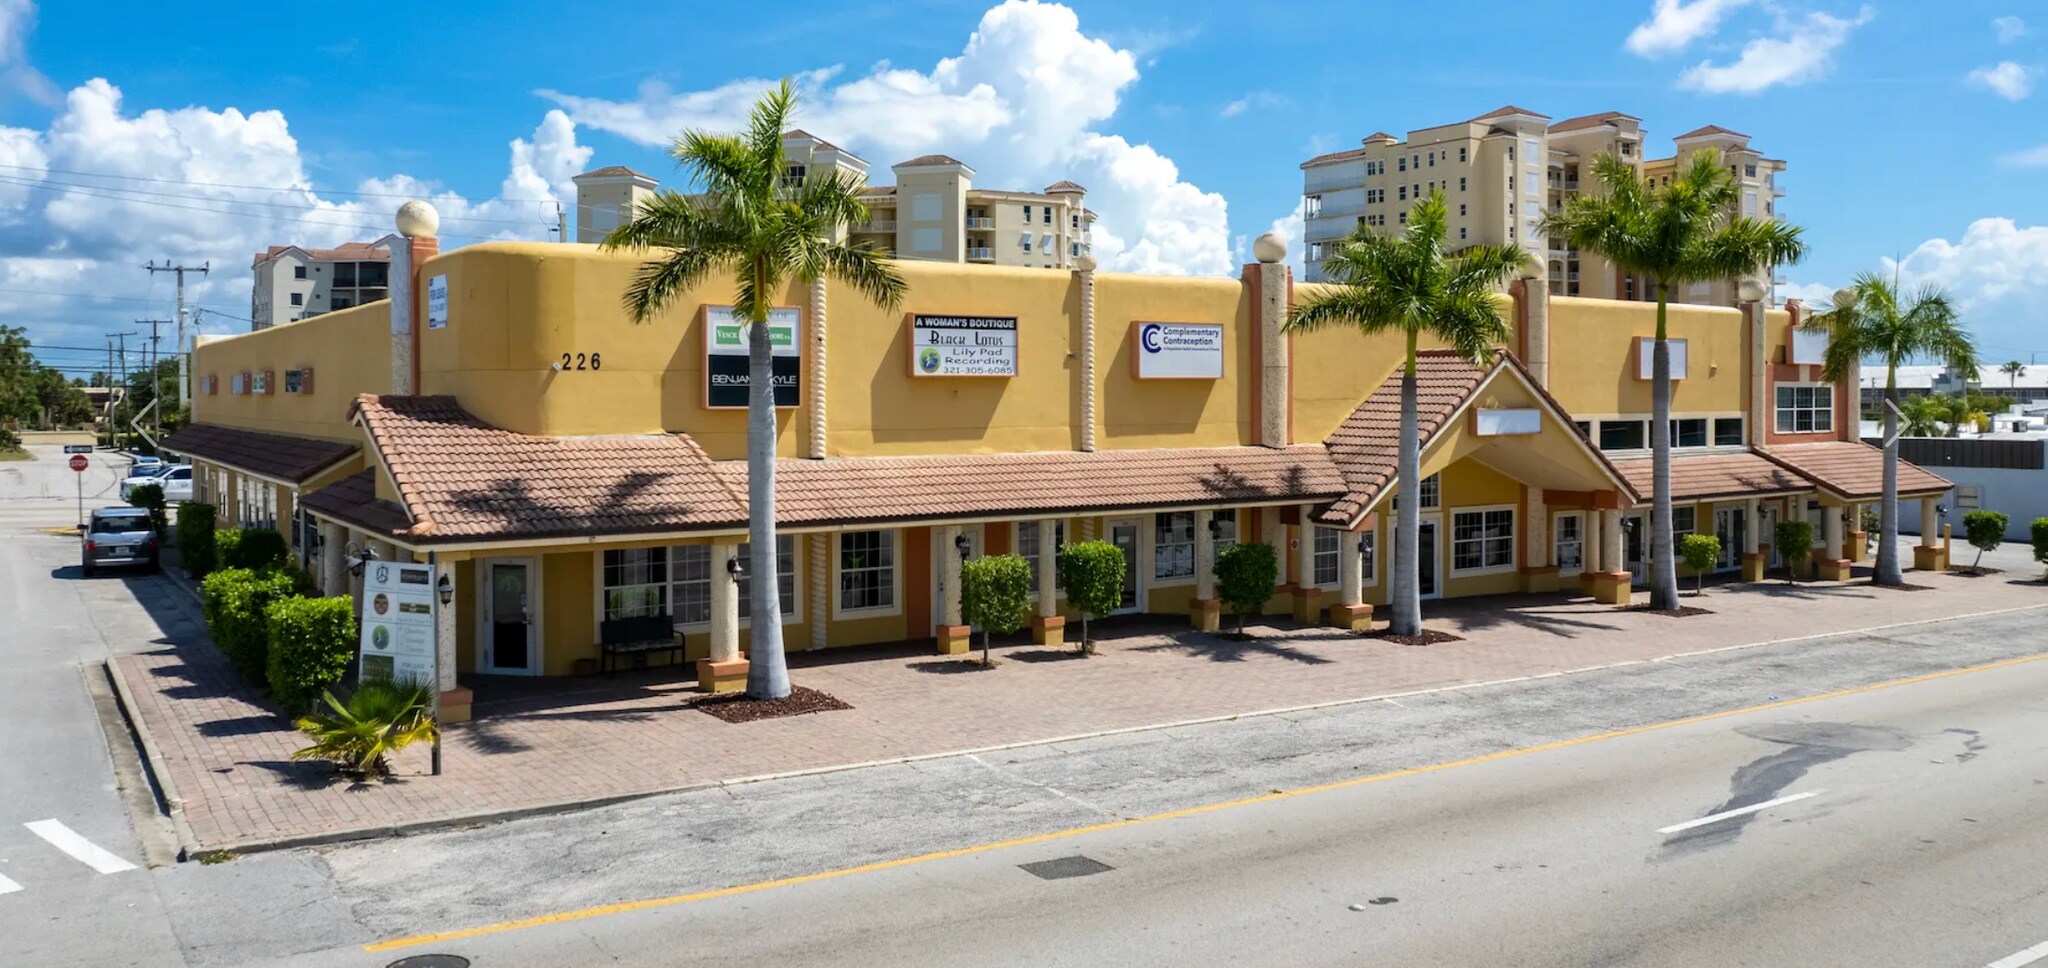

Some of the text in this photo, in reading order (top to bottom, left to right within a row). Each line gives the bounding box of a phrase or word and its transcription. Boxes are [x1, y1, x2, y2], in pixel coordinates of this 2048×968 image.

[916, 318, 1015, 329] A WOMAN'S BOUTIQUE
[1163, 326, 1219, 338] Complementary
[1163, 337, 1214, 346] Contraception
[953, 348, 1003, 357] Lily Pad
[562, 352, 601, 370] 226
[945, 357, 1010, 367] Recording
[943, 367, 1013, 375] 321-305-6085
[70, 459, 87, 467] STOP
